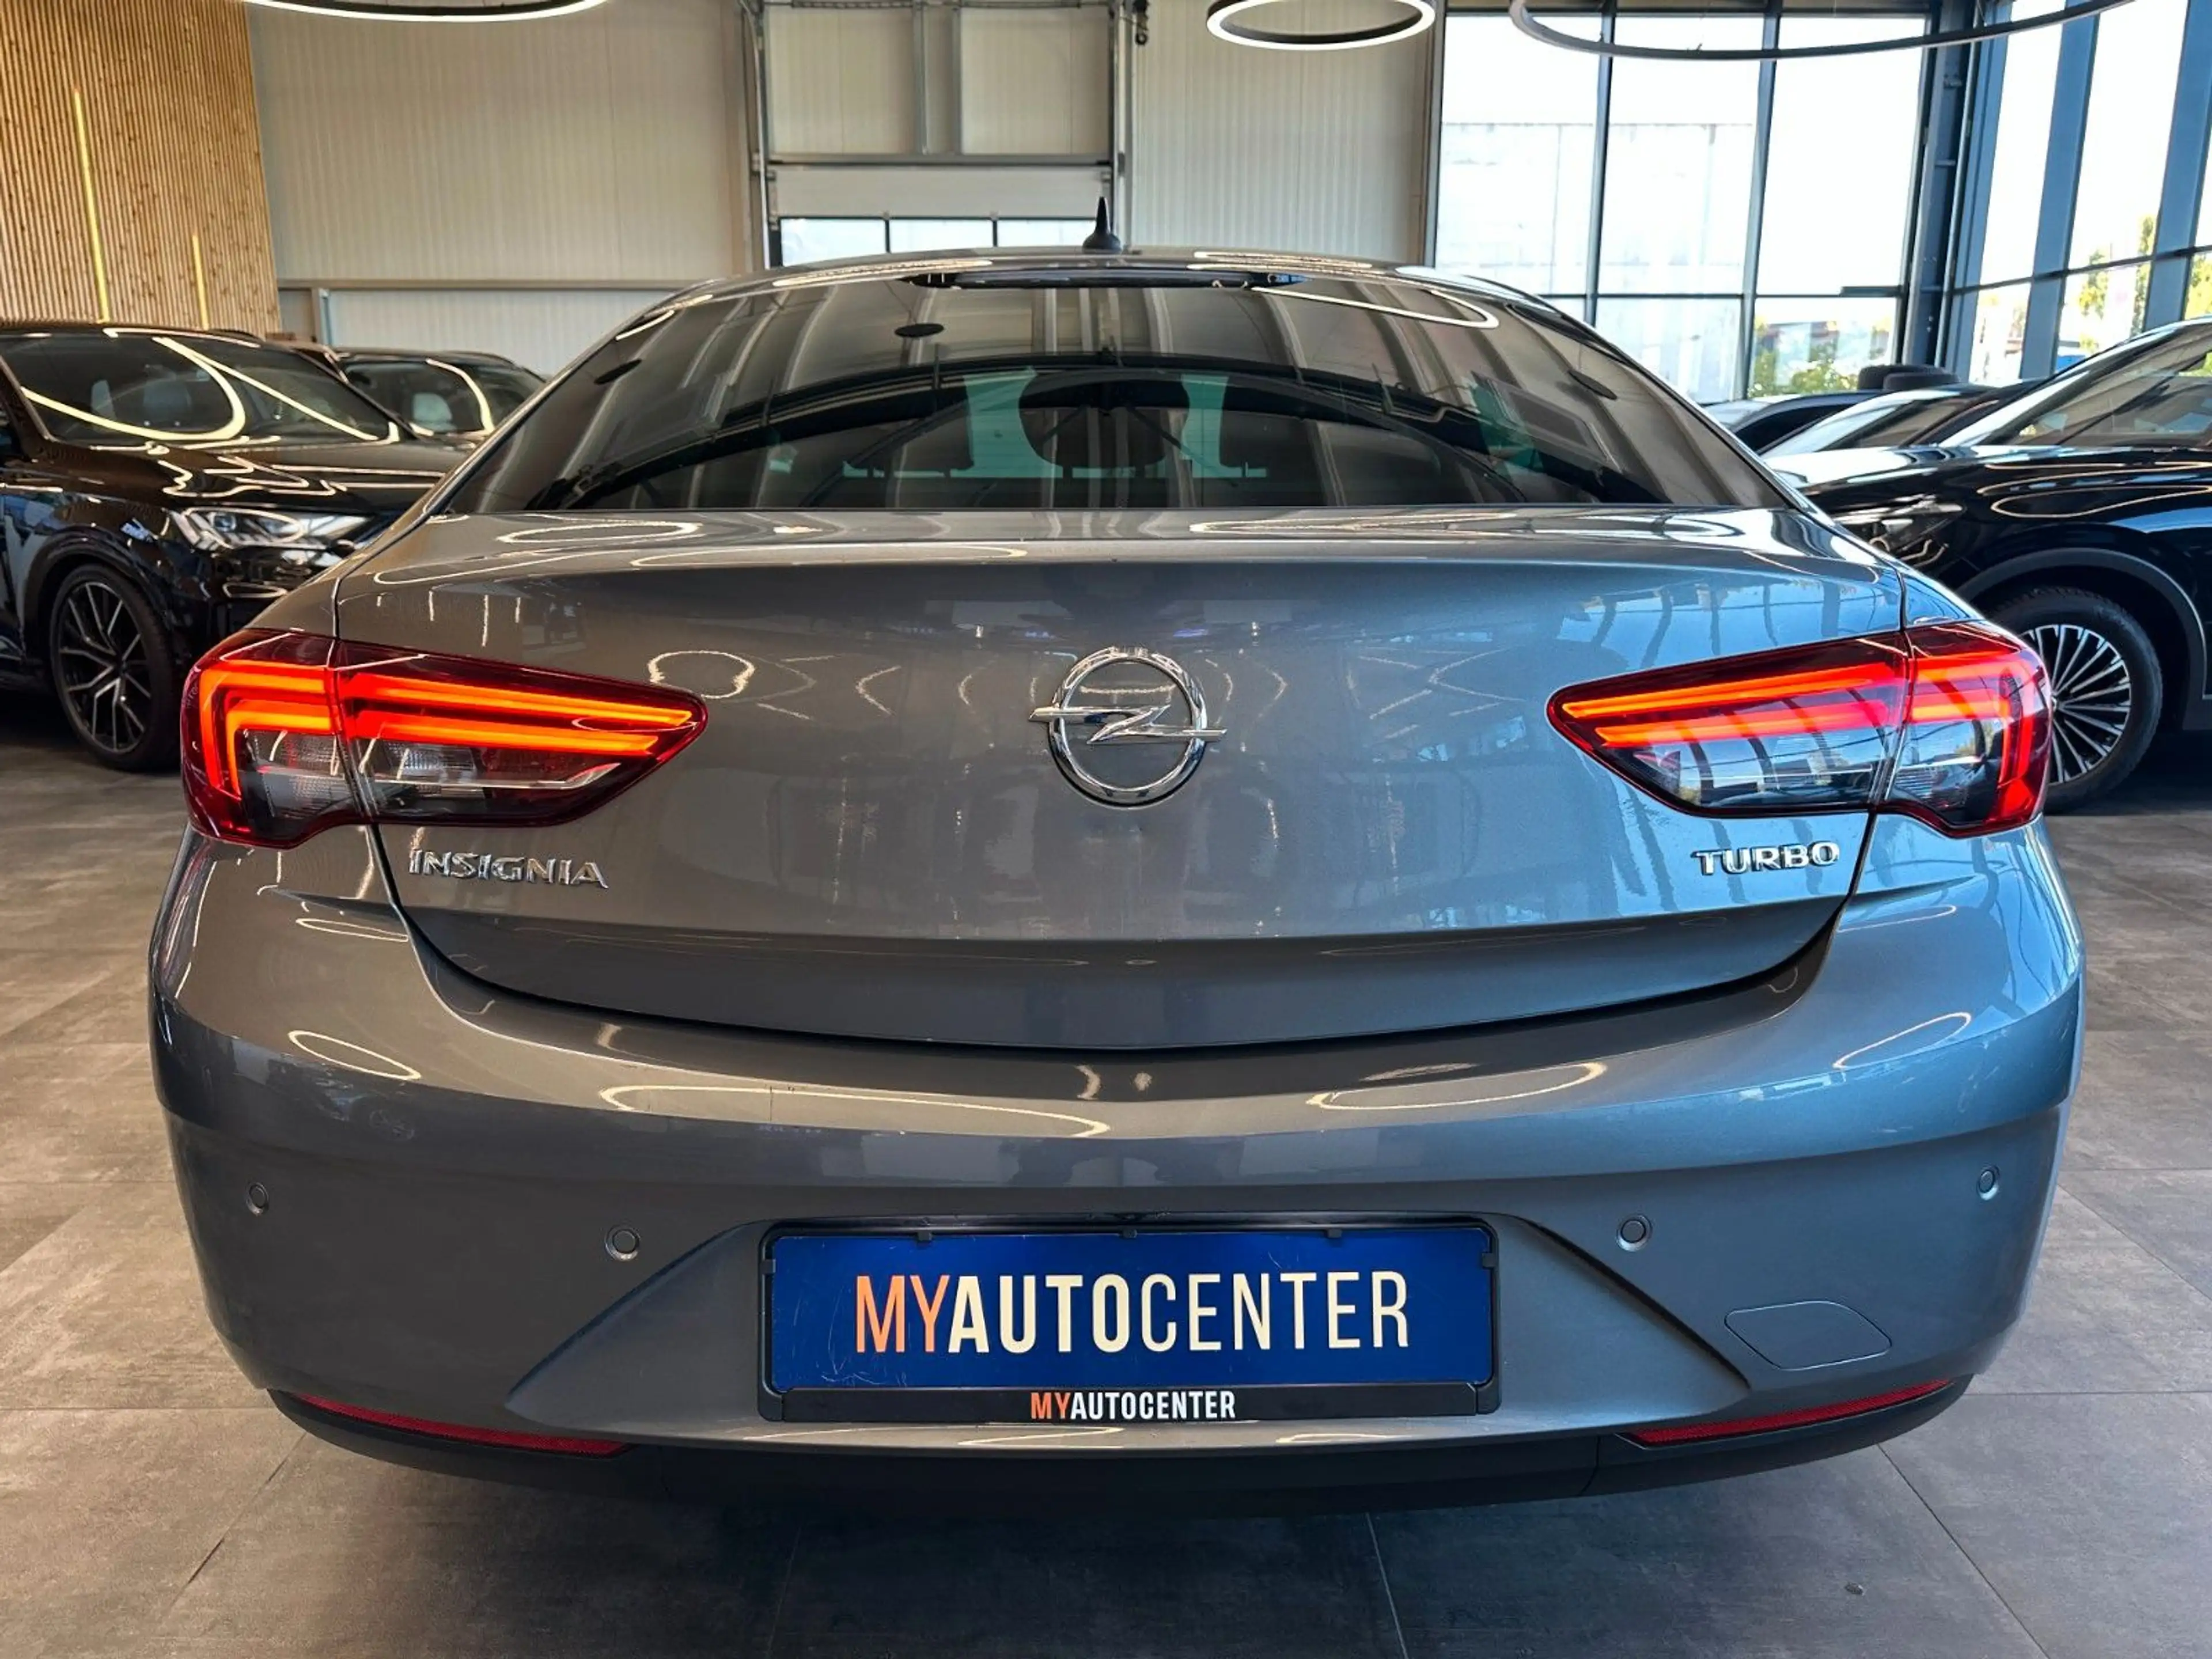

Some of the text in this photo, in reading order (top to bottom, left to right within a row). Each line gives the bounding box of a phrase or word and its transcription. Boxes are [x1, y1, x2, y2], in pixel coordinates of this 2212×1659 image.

[409, 849, 609, 889] INSIGNIA
[1691, 840, 1840, 876] TURBO
[855, 1271, 1408, 1353] MYAUTOCENTER
[1031, 1390, 1236, 1419] MYAUTOCENTER
